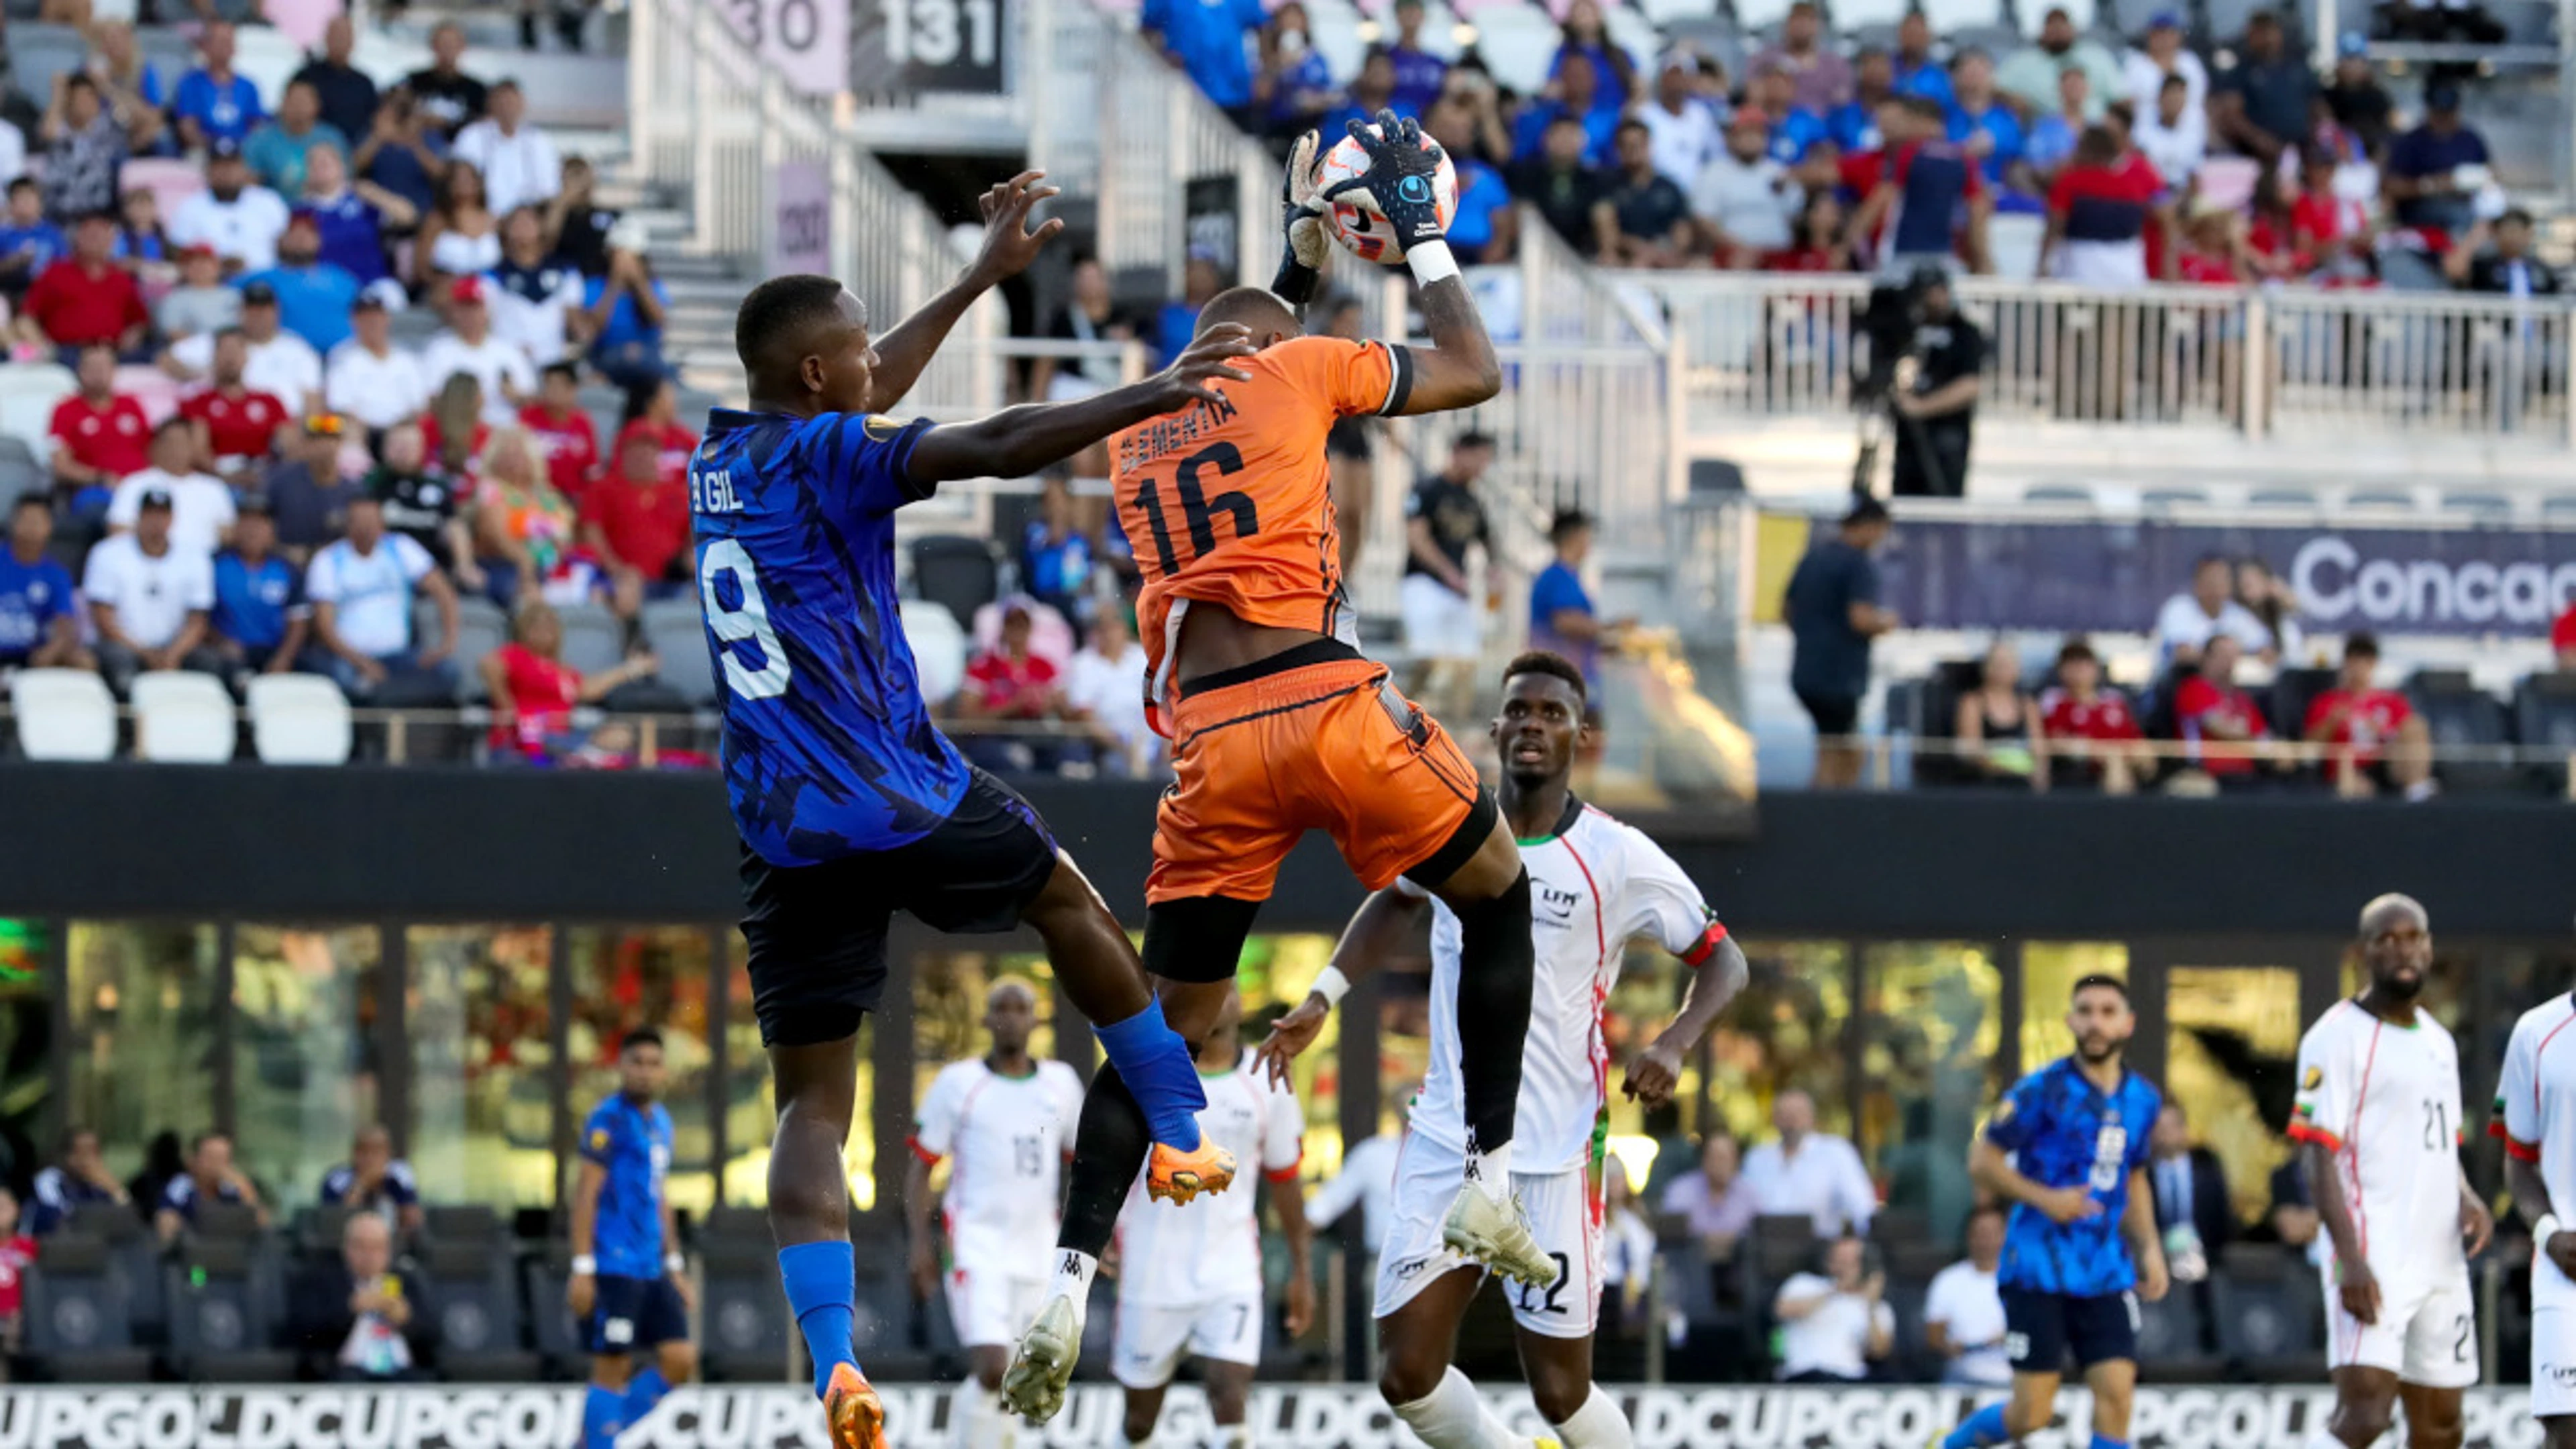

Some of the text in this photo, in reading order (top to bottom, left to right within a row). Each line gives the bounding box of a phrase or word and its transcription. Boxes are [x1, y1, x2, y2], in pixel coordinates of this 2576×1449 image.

[884, 0, 996, 66] 131
[705, 469, 744, 514] GIL
[1133, 441, 1259, 576] 16
[702, 538, 791, 701] 9
[2422, 1096, 2449, 1152] 21
[1230, 1301, 1250, 1344] 7
